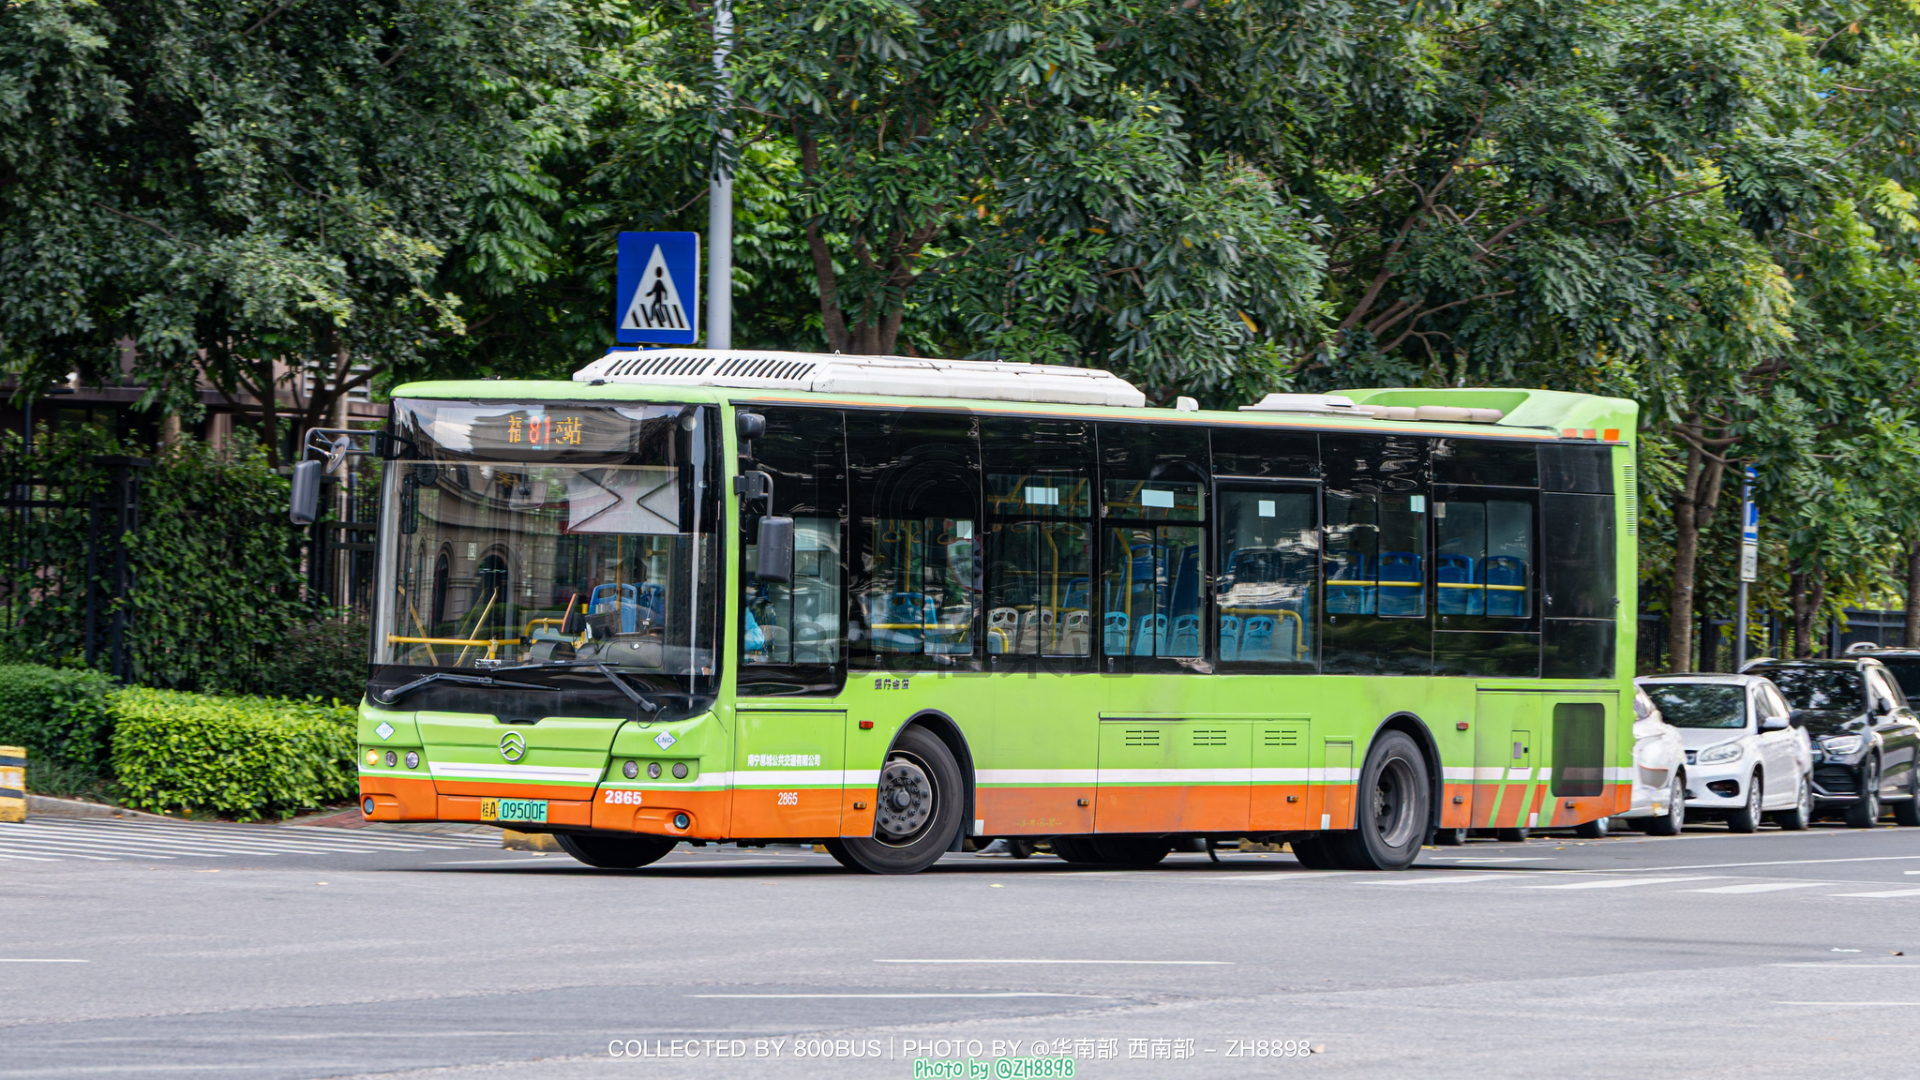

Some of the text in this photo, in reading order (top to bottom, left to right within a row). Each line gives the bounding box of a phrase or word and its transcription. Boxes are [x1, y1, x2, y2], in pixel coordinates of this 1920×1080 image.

[528, 415, 551, 444] 81
[657, 736, 673, 744] LNG
[604, 789, 642, 805] 2865
[777, 791, 798, 806] 2865
